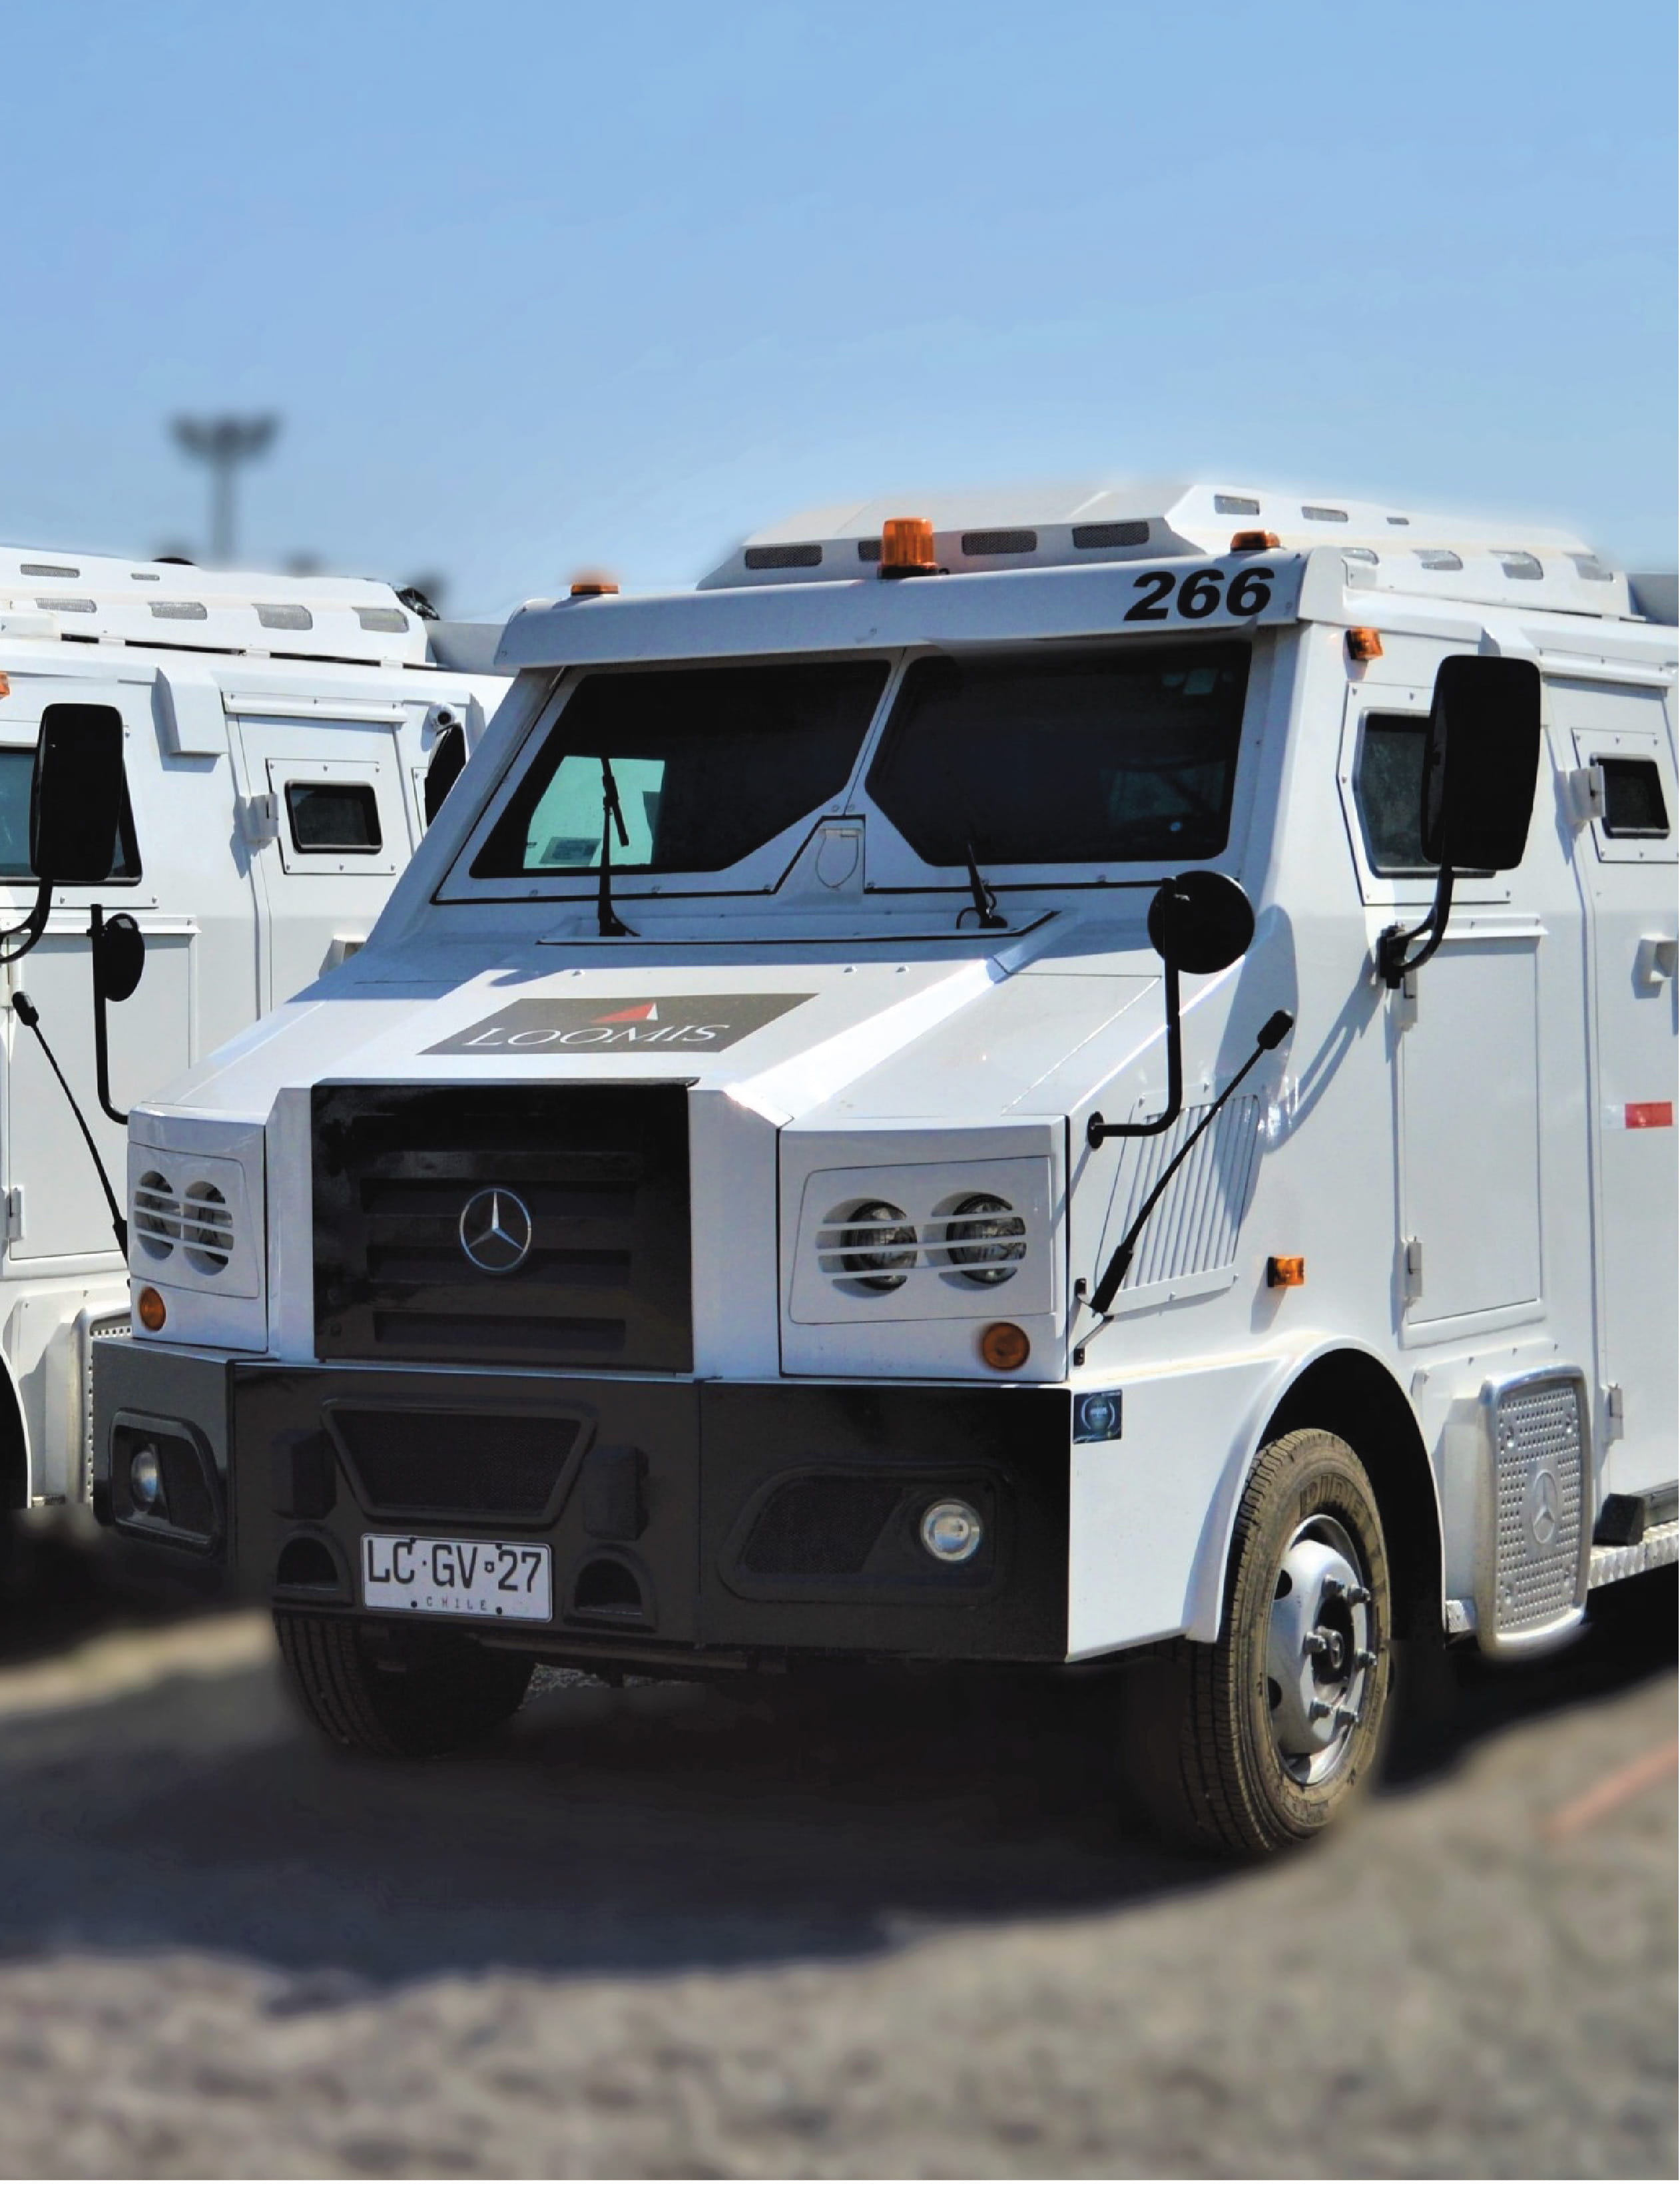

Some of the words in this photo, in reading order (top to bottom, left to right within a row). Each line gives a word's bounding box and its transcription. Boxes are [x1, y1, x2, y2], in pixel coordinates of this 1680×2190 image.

[1123, 567, 1275, 621] 266
[463, 1024, 730, 1046] LOOMIS
[425, 1596, 487, 1611] CHILE
